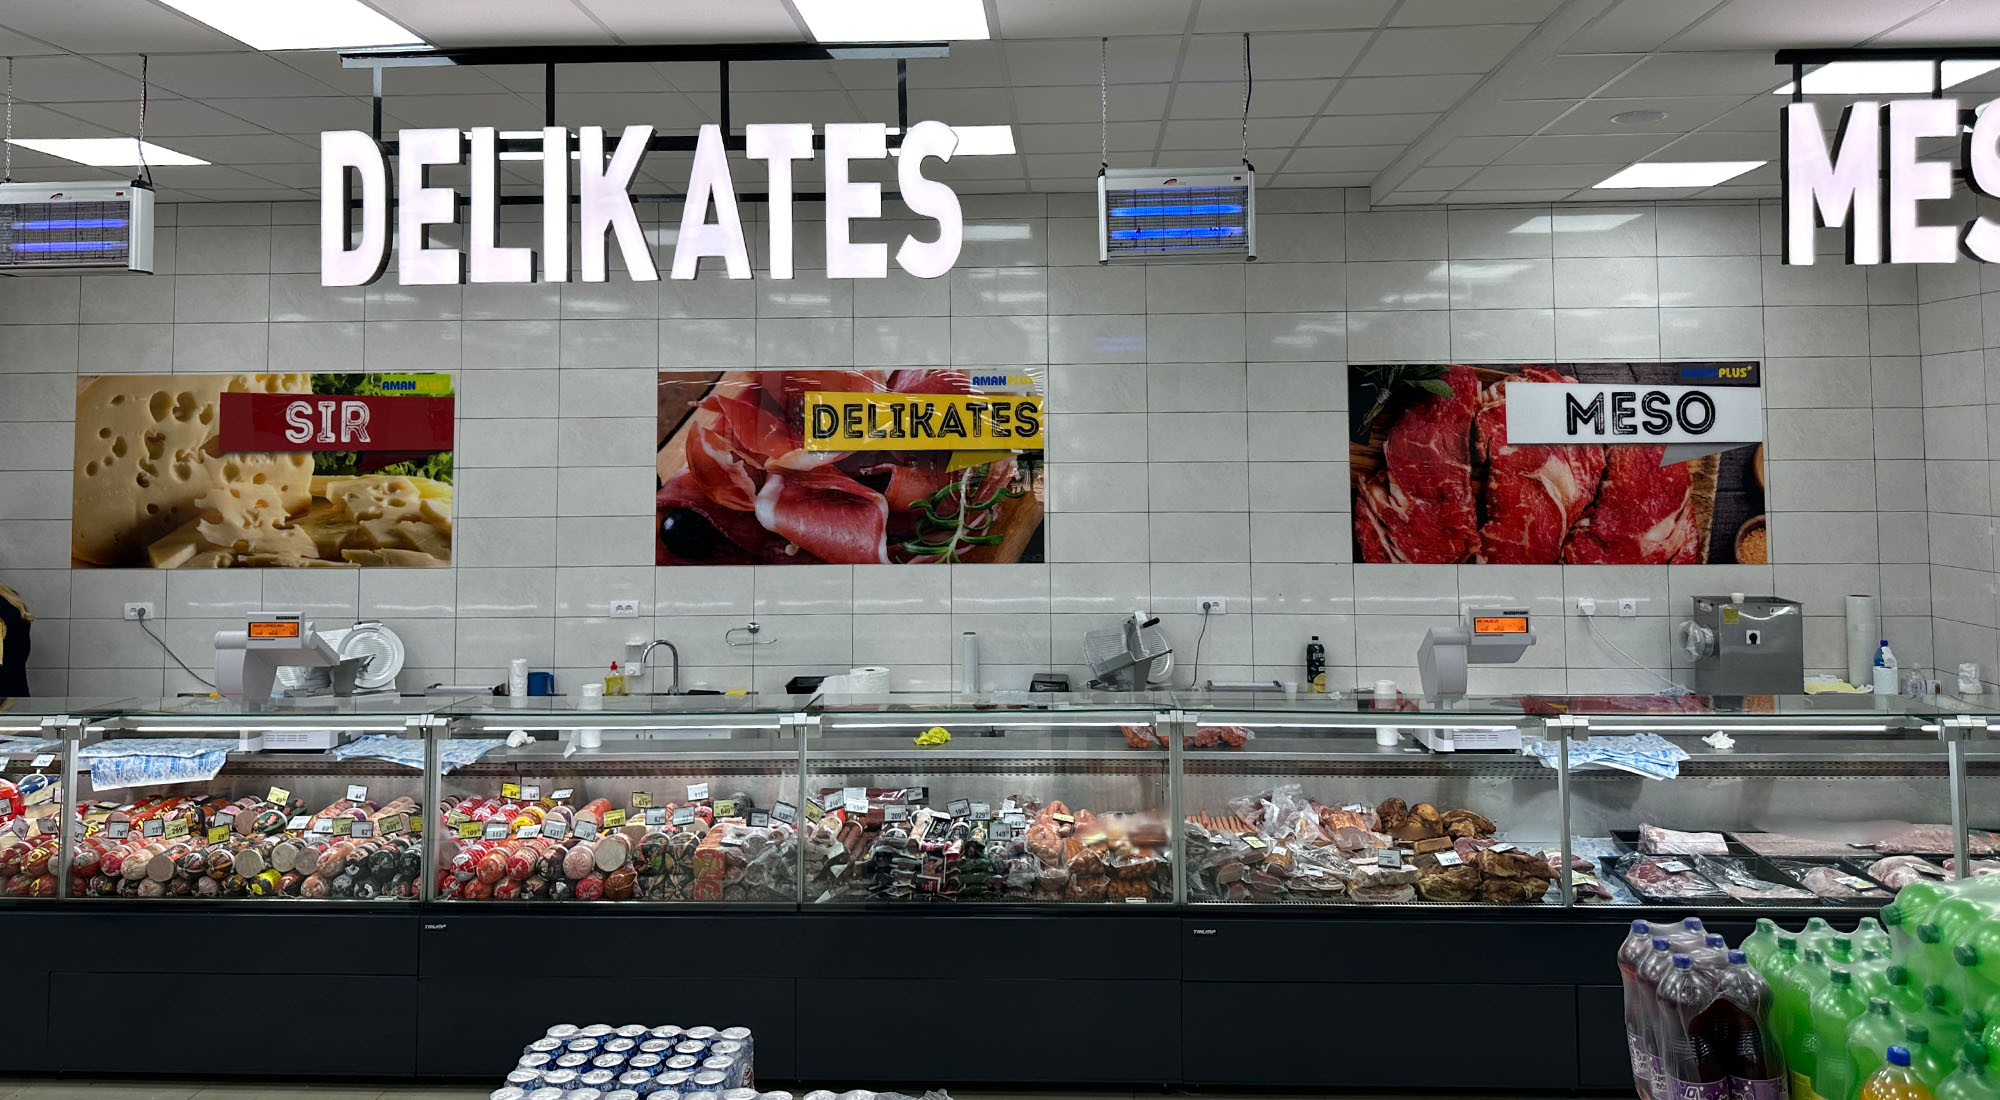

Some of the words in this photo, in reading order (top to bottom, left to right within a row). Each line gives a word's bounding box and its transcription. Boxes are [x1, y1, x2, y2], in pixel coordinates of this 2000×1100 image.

[320, 120, 963, 287] DELIKATES
[382, 381, 416, 391] AMAN
[972, 376, 1007, 386] AMAN
[1718, 367, 1747, 378] PLUS
[285, 401, 371, 444] SIR
[812, 401, 1040, 438] DELIKATES
[1566, 390, 1716, 435] MESO
